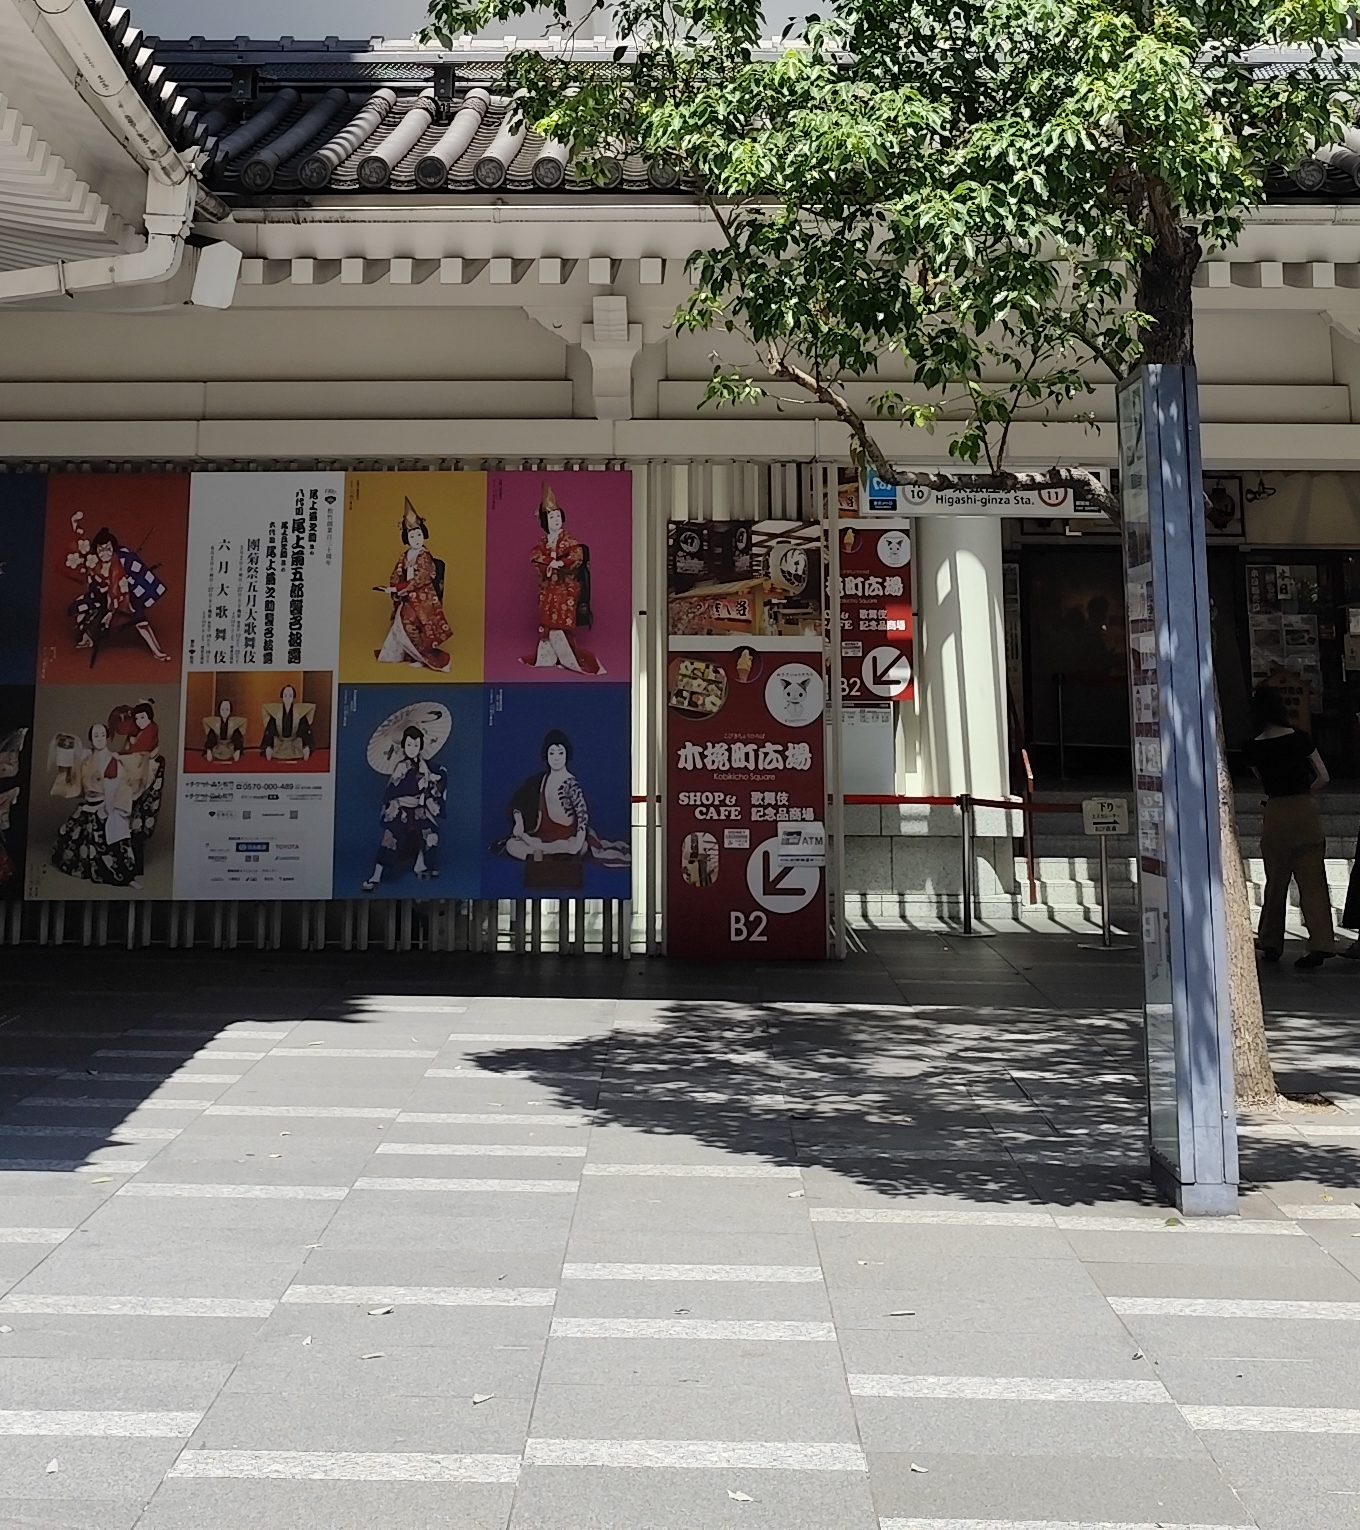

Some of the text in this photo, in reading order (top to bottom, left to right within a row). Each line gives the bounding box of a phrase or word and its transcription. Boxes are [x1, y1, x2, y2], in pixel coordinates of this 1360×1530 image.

[911, 489, 925, 499] 10
[935, 494, 1035, 507] Higashi-ginza Sta.
[214, 538, 231, 665] 六月大歌舞伎
[677, 741, 813, 771] 木挽町広場
[750, 772, 776, 781] Square
[750, 791, 790, 806] 歌舞伎
[694, 806, 742, 820] CAFE
[1096, 801, 1114, 813] 下り
[802, 836, 824, 846] ATM
[729, 910, 768, 942] B2
